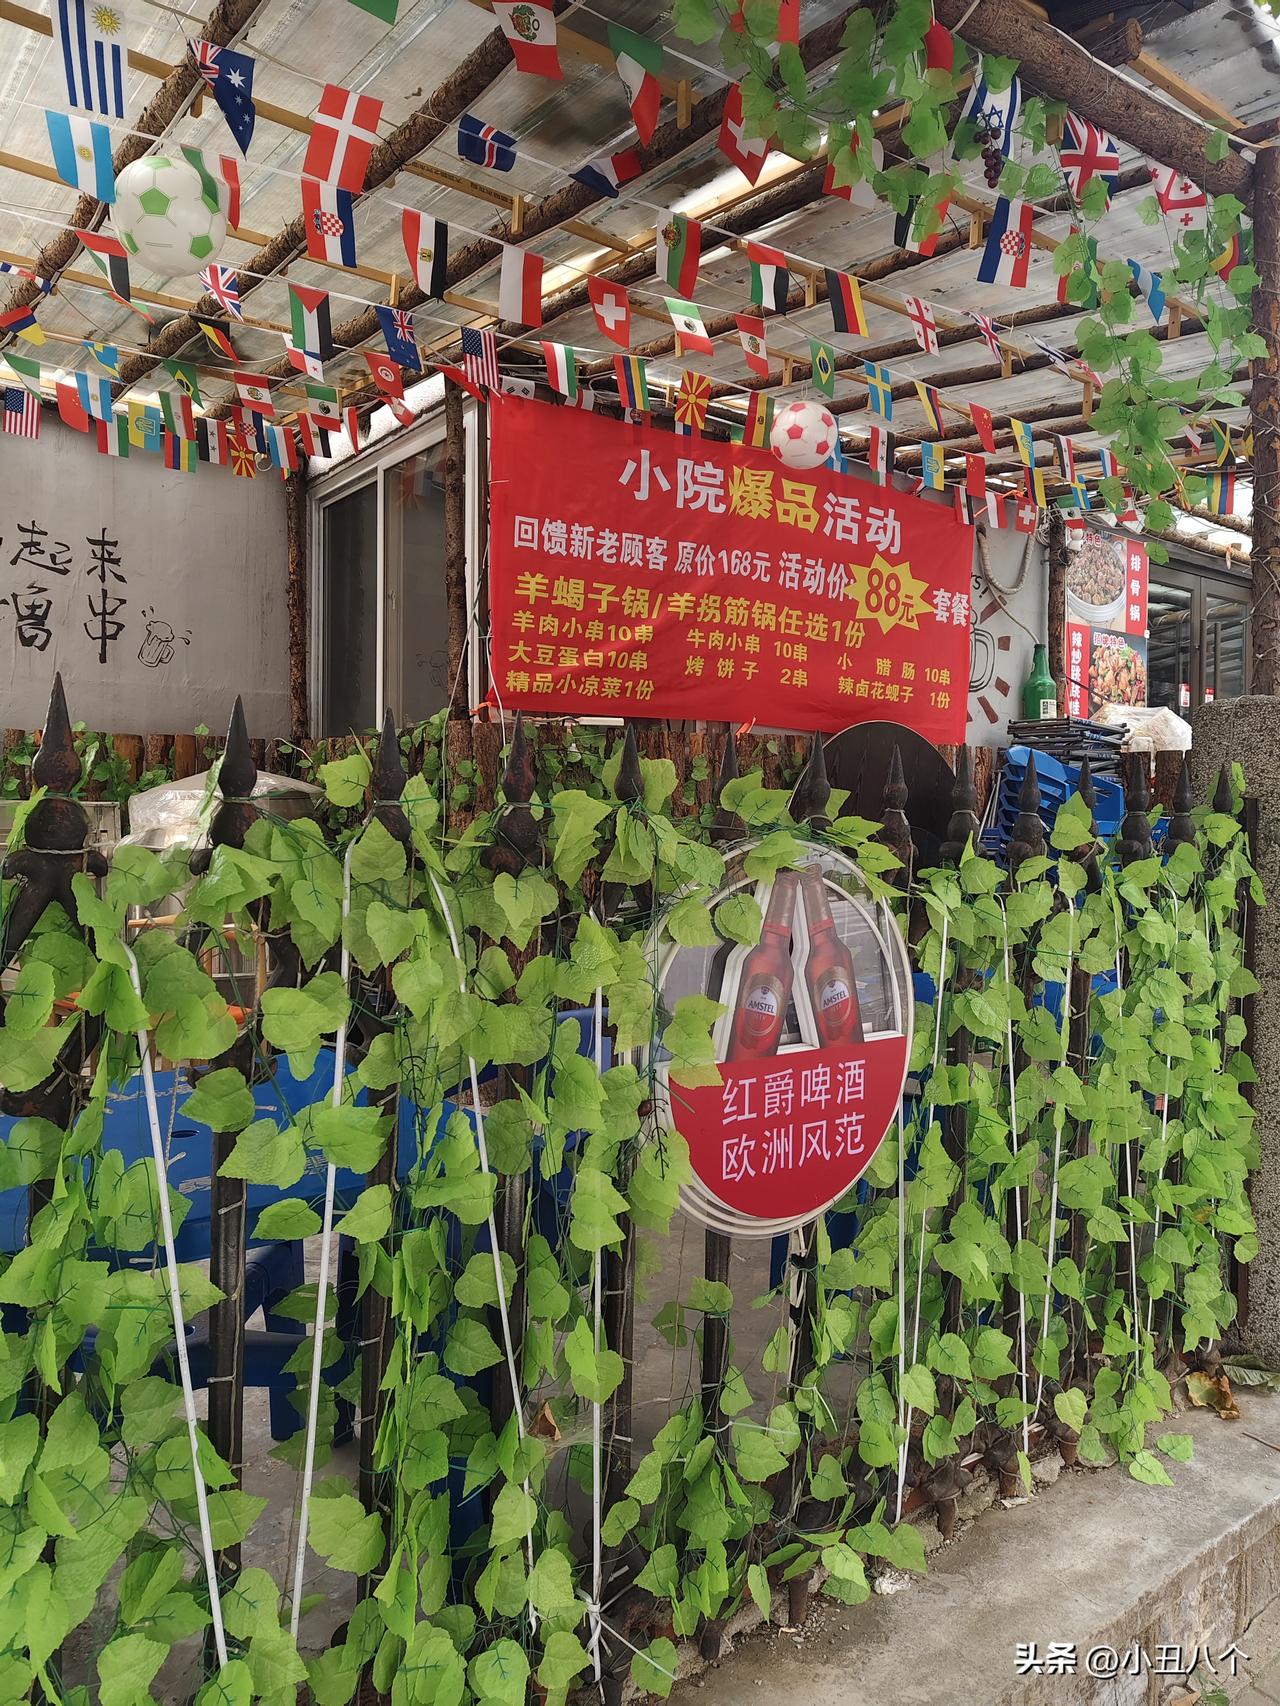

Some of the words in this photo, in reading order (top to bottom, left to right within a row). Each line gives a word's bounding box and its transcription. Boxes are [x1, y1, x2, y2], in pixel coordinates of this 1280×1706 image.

[618, 449, 901, 554] 小院爆品活动
[0, 520, 127, 584] 起来
[513, 515, 668, 571] 回馈新老顾客
[674, 541, 771, 583] 原价168元
[865, 567, 914, 624] 88元
[932, 588, 970, 628] 套餐
[1129, 553, 1142, 622] 排骨锅
[511, 609, 654, 645] 羊肉小串10串
[514, 571, 866, 649] 羊蝎子锅/羊拐筋锅任选1份
[508, 640, 648, 672] 大豆蛋白10串
[686, 628, 761, 655] 牛肉小串
[773, 640, 809, 663] 10串
[505, 670, 655, 701] 精品小凉菜1份
[780, 668, 808, 689] 2串
[837, 676, 914, 705] 辣卤花蚬子
[929, 691, 951, 710] 1份
[924, 667, 951, 687] 10串
[747, 1000, 775, 1014] AMSTEL
[822, 990, 848, 1008] AMSTEL
[721, 1058, 866, 1126] 红爵啤酒
[721, 1112, 866, 1183] 欧洲风范
